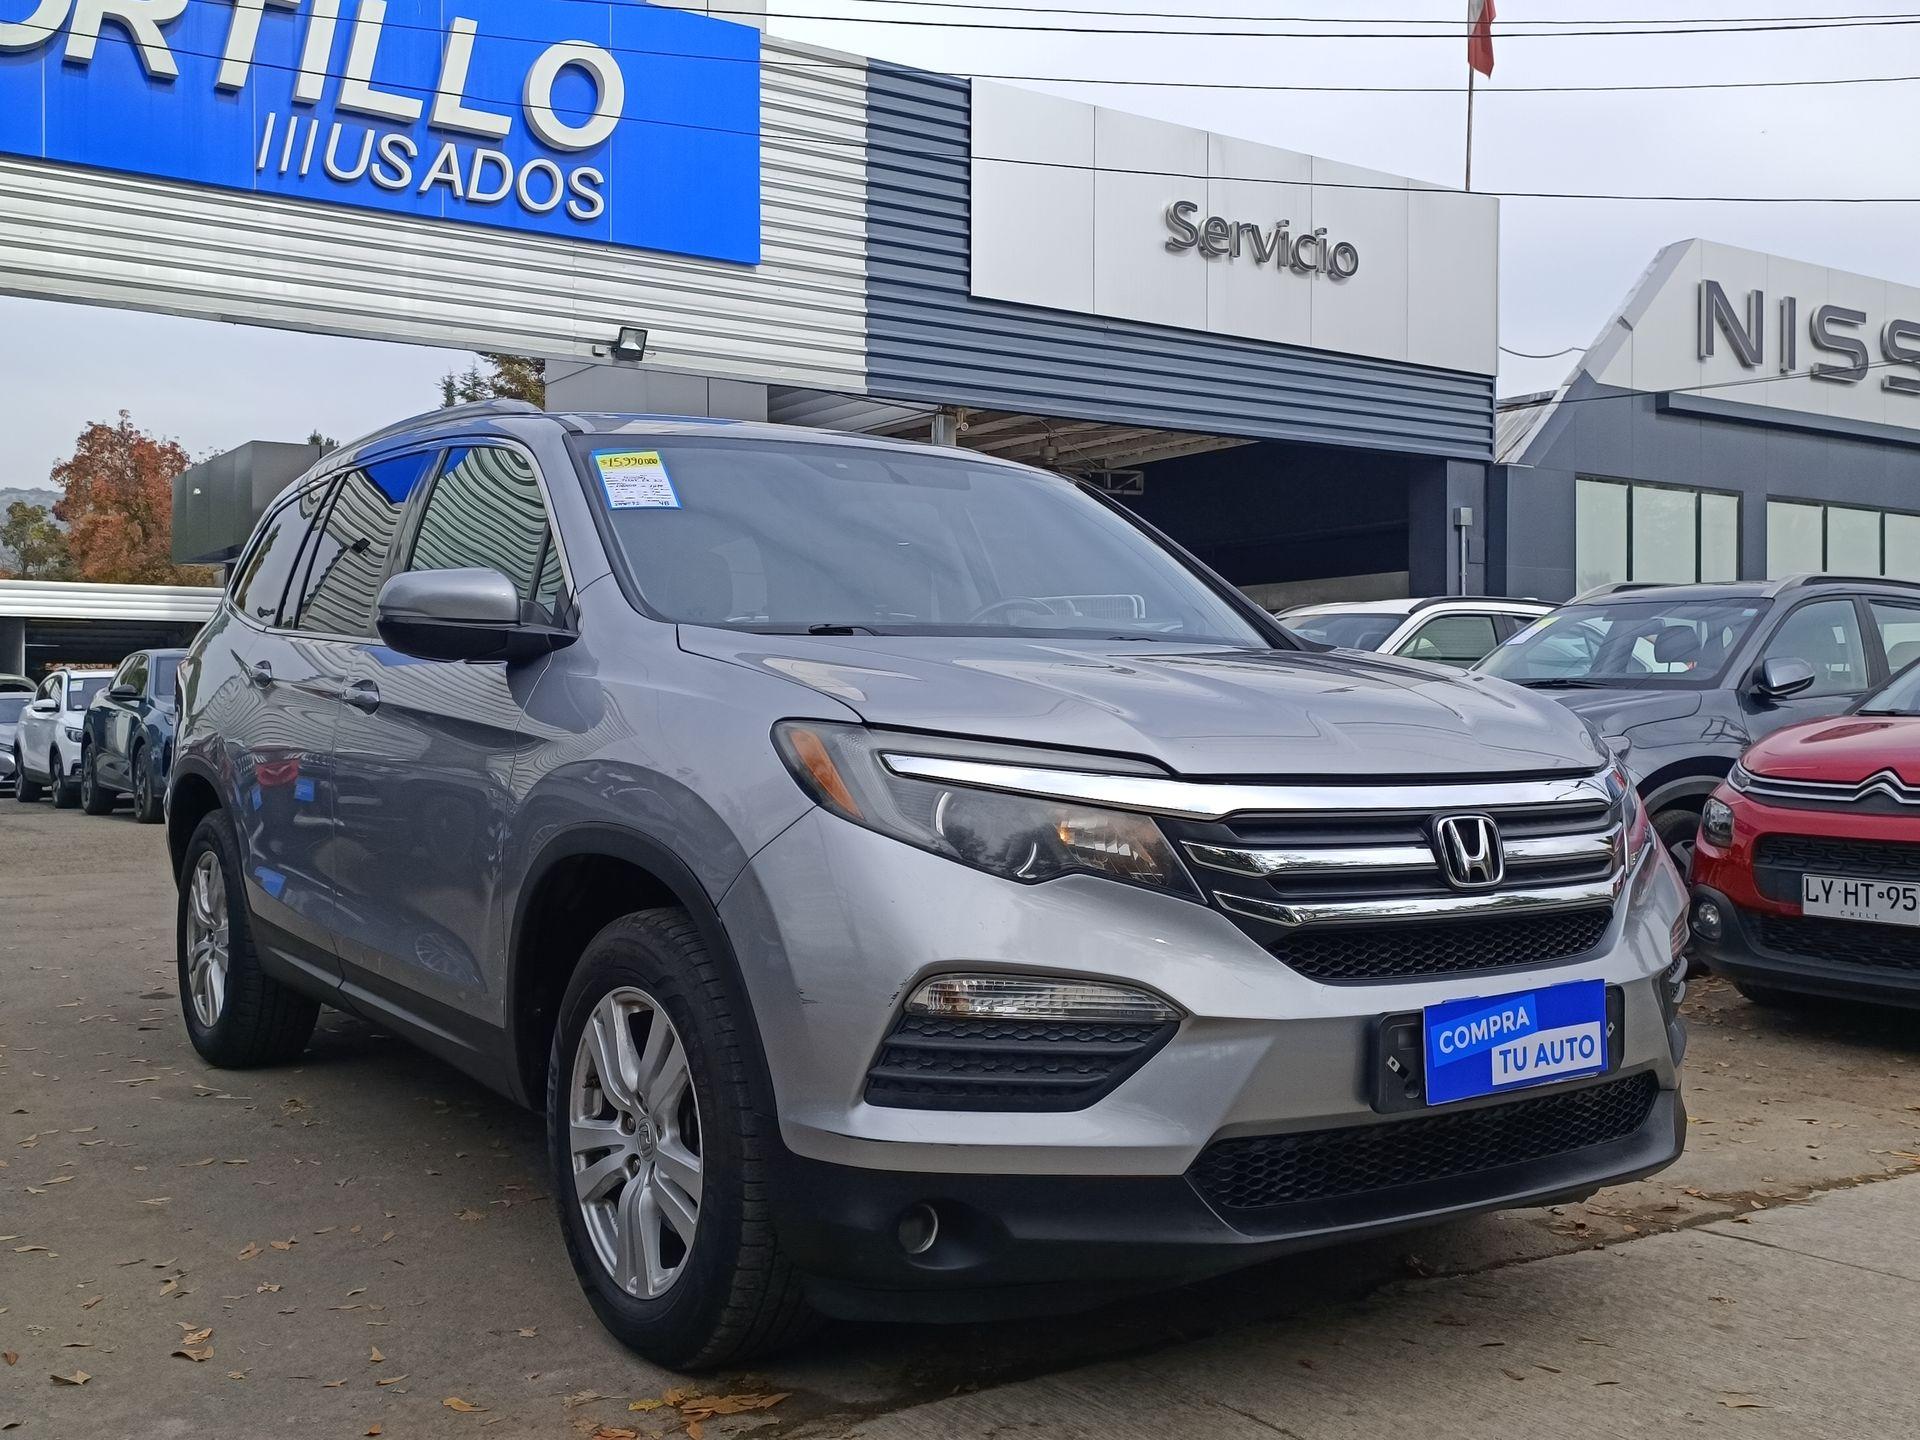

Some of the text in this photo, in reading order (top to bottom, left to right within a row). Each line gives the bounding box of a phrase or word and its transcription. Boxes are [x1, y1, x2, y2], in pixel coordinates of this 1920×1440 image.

[1166, 200, 1359, 278] Servicio
[1840, 910, 1879, 919] CHILE
[1439, 1006, 1531, 1054] COMPRA
[1499, 1034, 1595, 1073] TU AUTO
